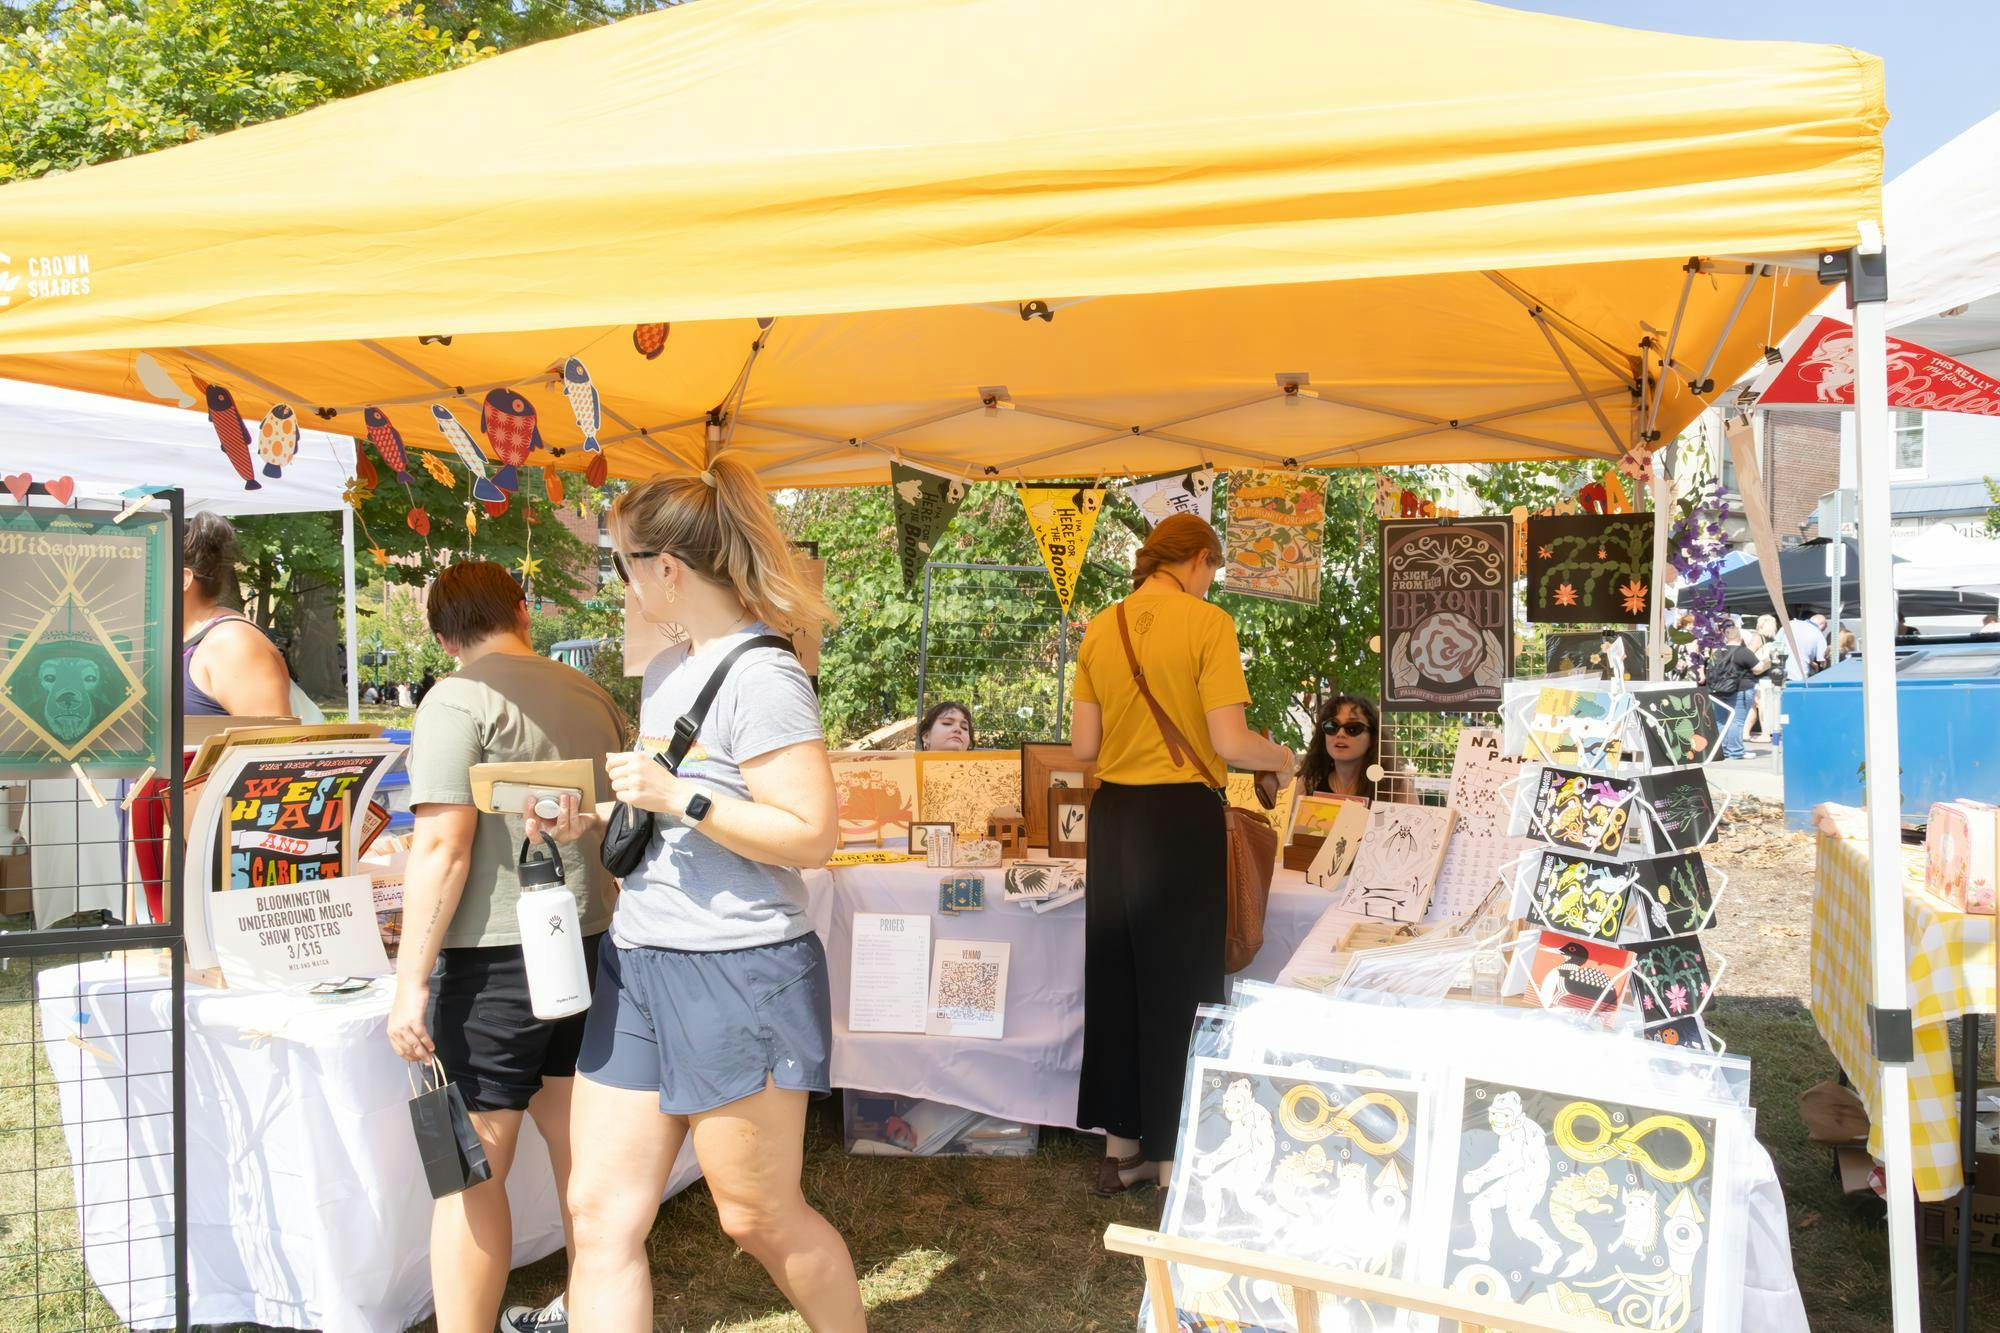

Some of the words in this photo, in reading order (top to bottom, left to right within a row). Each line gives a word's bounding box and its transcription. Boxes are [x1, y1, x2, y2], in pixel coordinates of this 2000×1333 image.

[28, 254, 89, 277] CROWN
[28, 277, 91, 298] SHADES
[1922, 365, 1946, 377] my
[1940, 372, 1967, 389] first
[1930, 357, 1955, 370] THIS
[1954, 366, 1994, 391] REALLY
[1893, 376, 2000, 415] Rodeo
[921, 491, 938, 523] HERE
[1050, 526, 1060, 542] THE
[1057, 508, 1076, 538] HERE
[1067, 540, 1076, 557] FOR
[0, 533, 143, 560] Midsommar
[1392, 571, 1401, 580] A
[1403, 570, 1429, 580] SIGN
[1392, 580, 1424, 590] FROM
[1390, 589, 1505, 630] BEYOND
[243, 776, 359, 815] WEST
[231, 798, 343, 832] HEAD
[259, 834, 309, 854] AND
[256, 889, 331, 912] BLOOMINGTON
[238, 907, 317, 932] UNDERGROUND
[319, 902, 353, 920] MUSIC
[879, 918, 905, 932] PRICES
[258, 928, 291, 946] SHOW
[294, 921, 341, 942] POSTERS
[287, 941, 323, 959] 3/$15
[962, 950, 982, 960] VENMO
